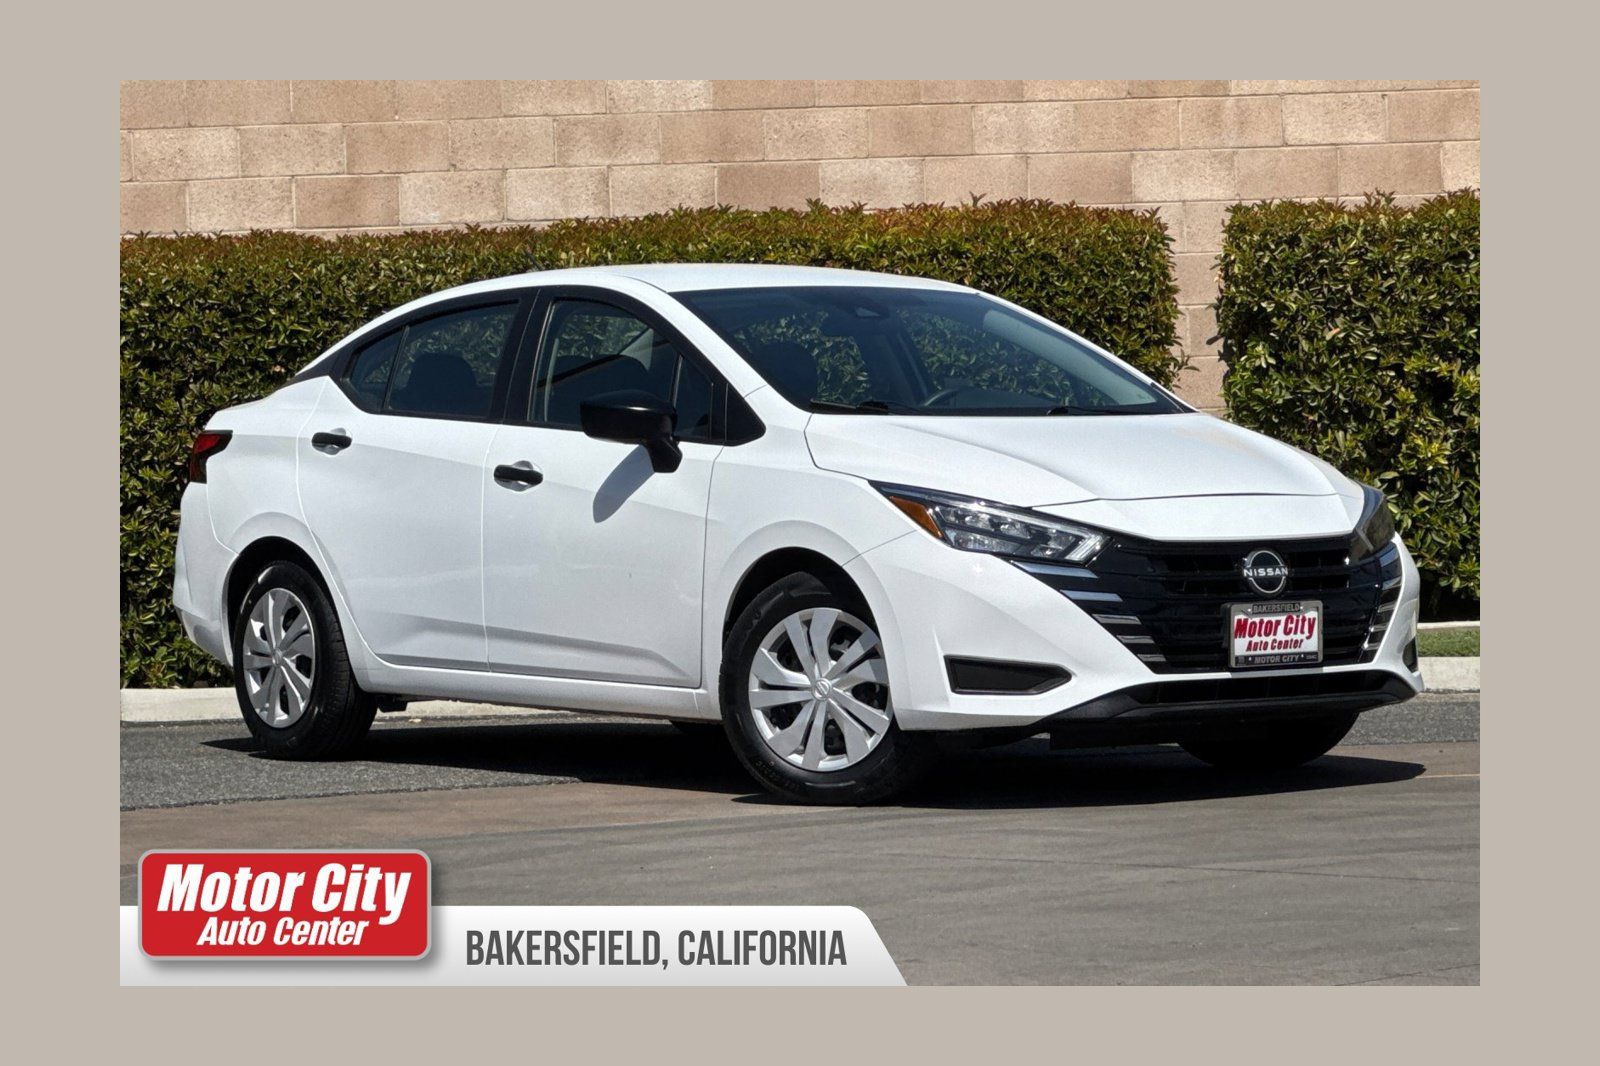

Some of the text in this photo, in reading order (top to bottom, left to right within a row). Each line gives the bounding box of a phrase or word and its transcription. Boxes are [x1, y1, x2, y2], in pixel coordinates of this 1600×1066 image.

[1243, 567, 1289, 577] NISSAN
[1253, 603, 1300, 613] BAKERSFIELD
[1234, 614, 1316, 640] Motor City
[1246, 638, 1304, 652] Auto Center
[1254, 655, 1281, 664] MOTOR
[1282, 654, 1300, 663] CITY
